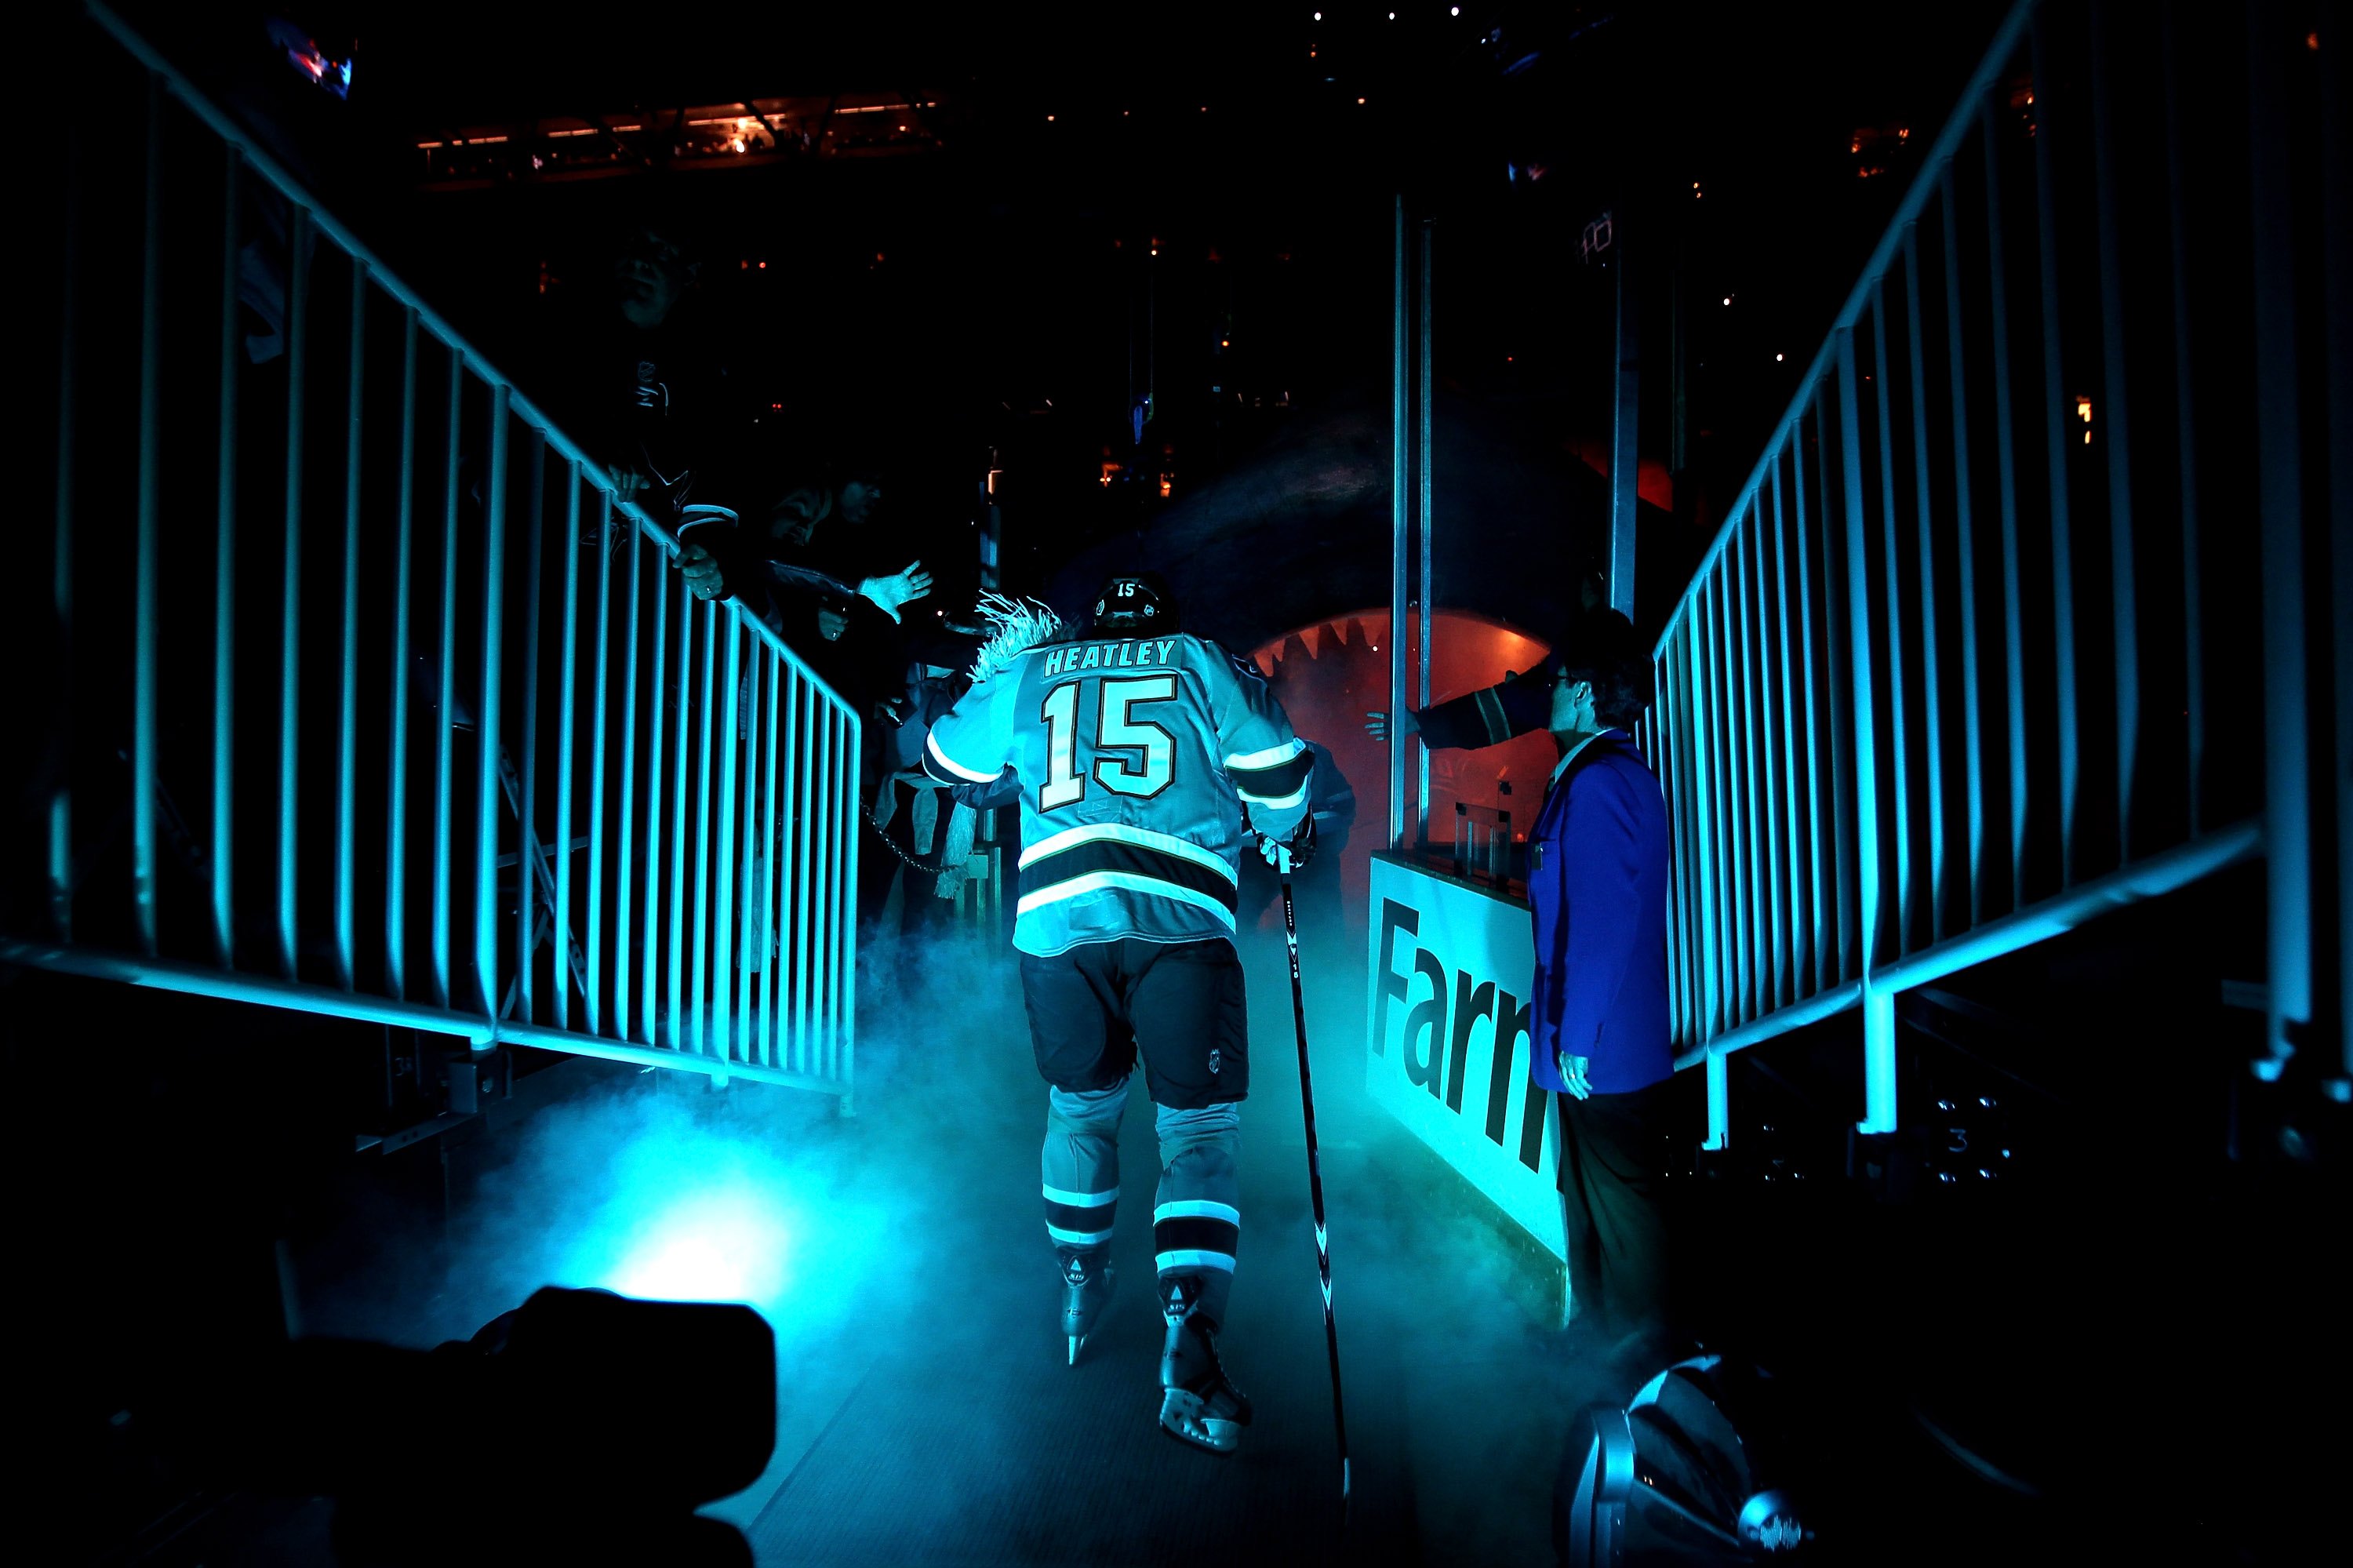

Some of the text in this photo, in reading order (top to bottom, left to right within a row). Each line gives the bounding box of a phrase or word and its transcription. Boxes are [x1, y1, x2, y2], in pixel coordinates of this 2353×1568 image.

[1118, 583, 1136, 597] 15
[1044, 639, 1176, 678] HEATLEY
[1038, 674, 1178, 814] 15
